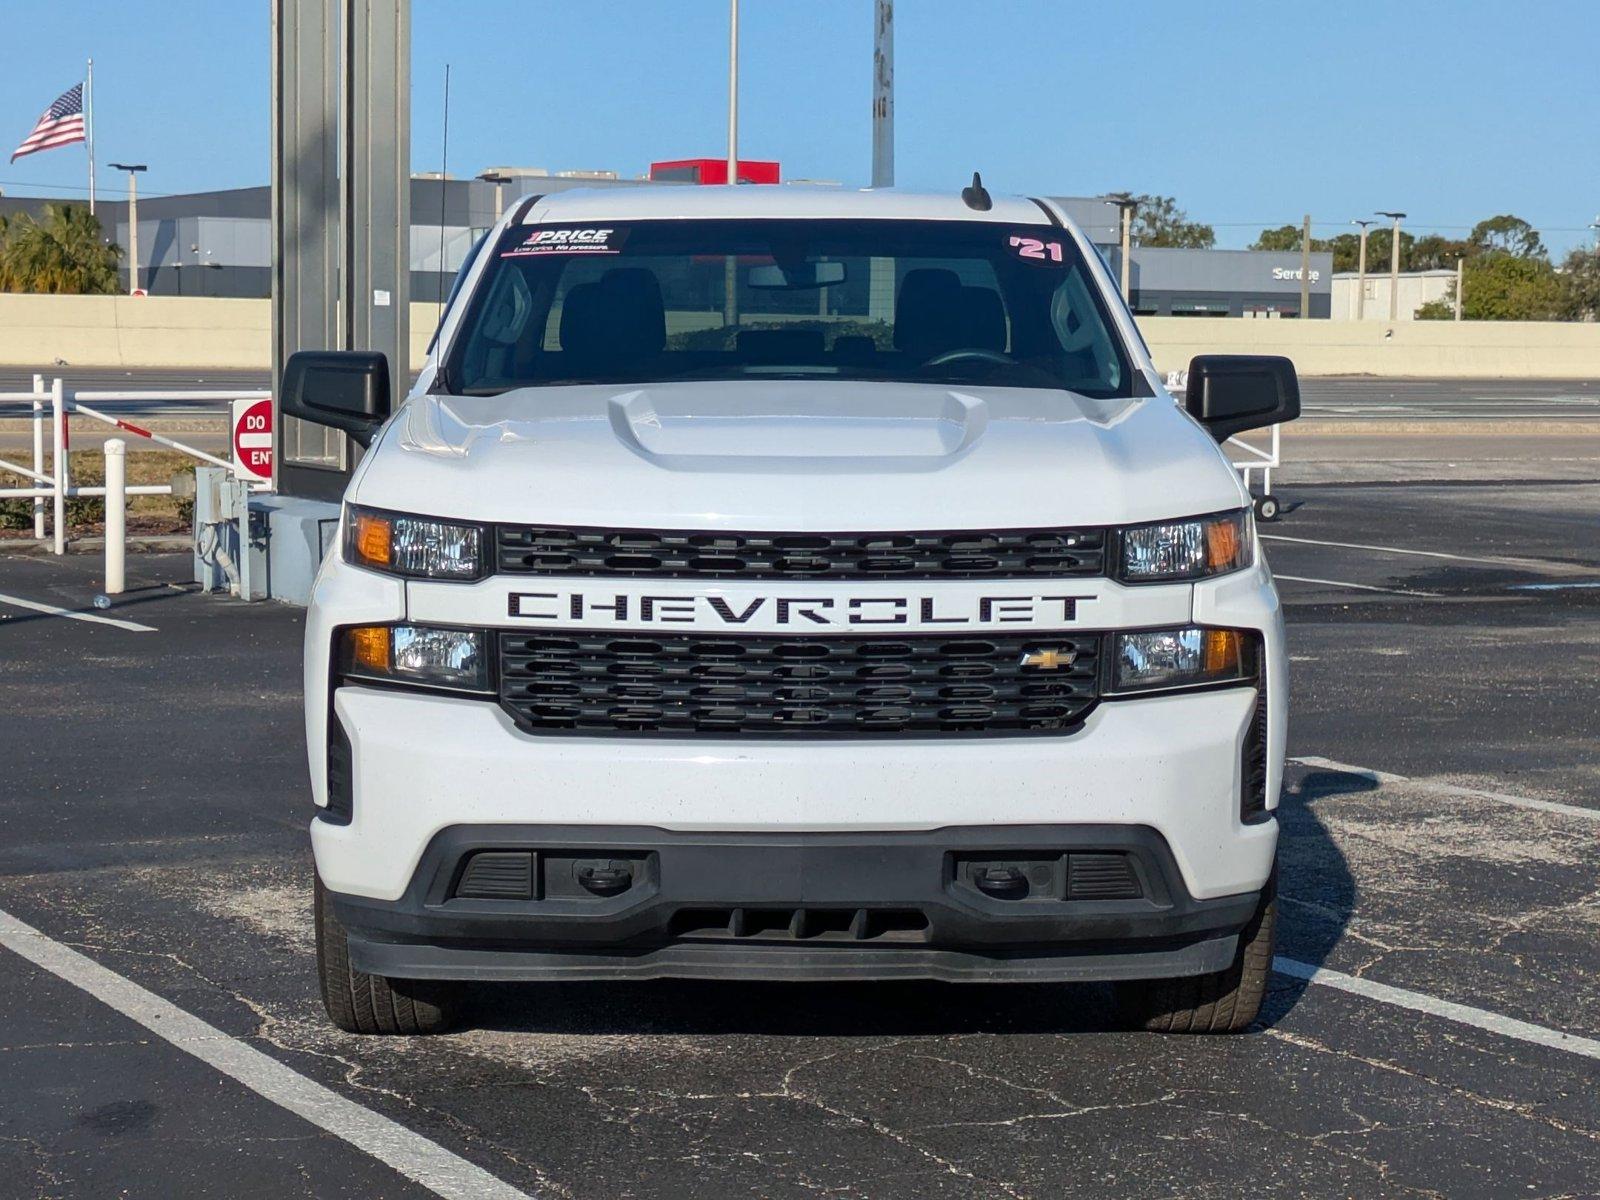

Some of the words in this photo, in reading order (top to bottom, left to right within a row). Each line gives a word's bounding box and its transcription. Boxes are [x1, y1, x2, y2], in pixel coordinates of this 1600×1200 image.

[1009, 236, 1063, 262] '21
[1273, 267, 1319, 280] Servie
[247, 415, 265, 429] DO
[508, 592, 1098, 624] CHEVROLET
